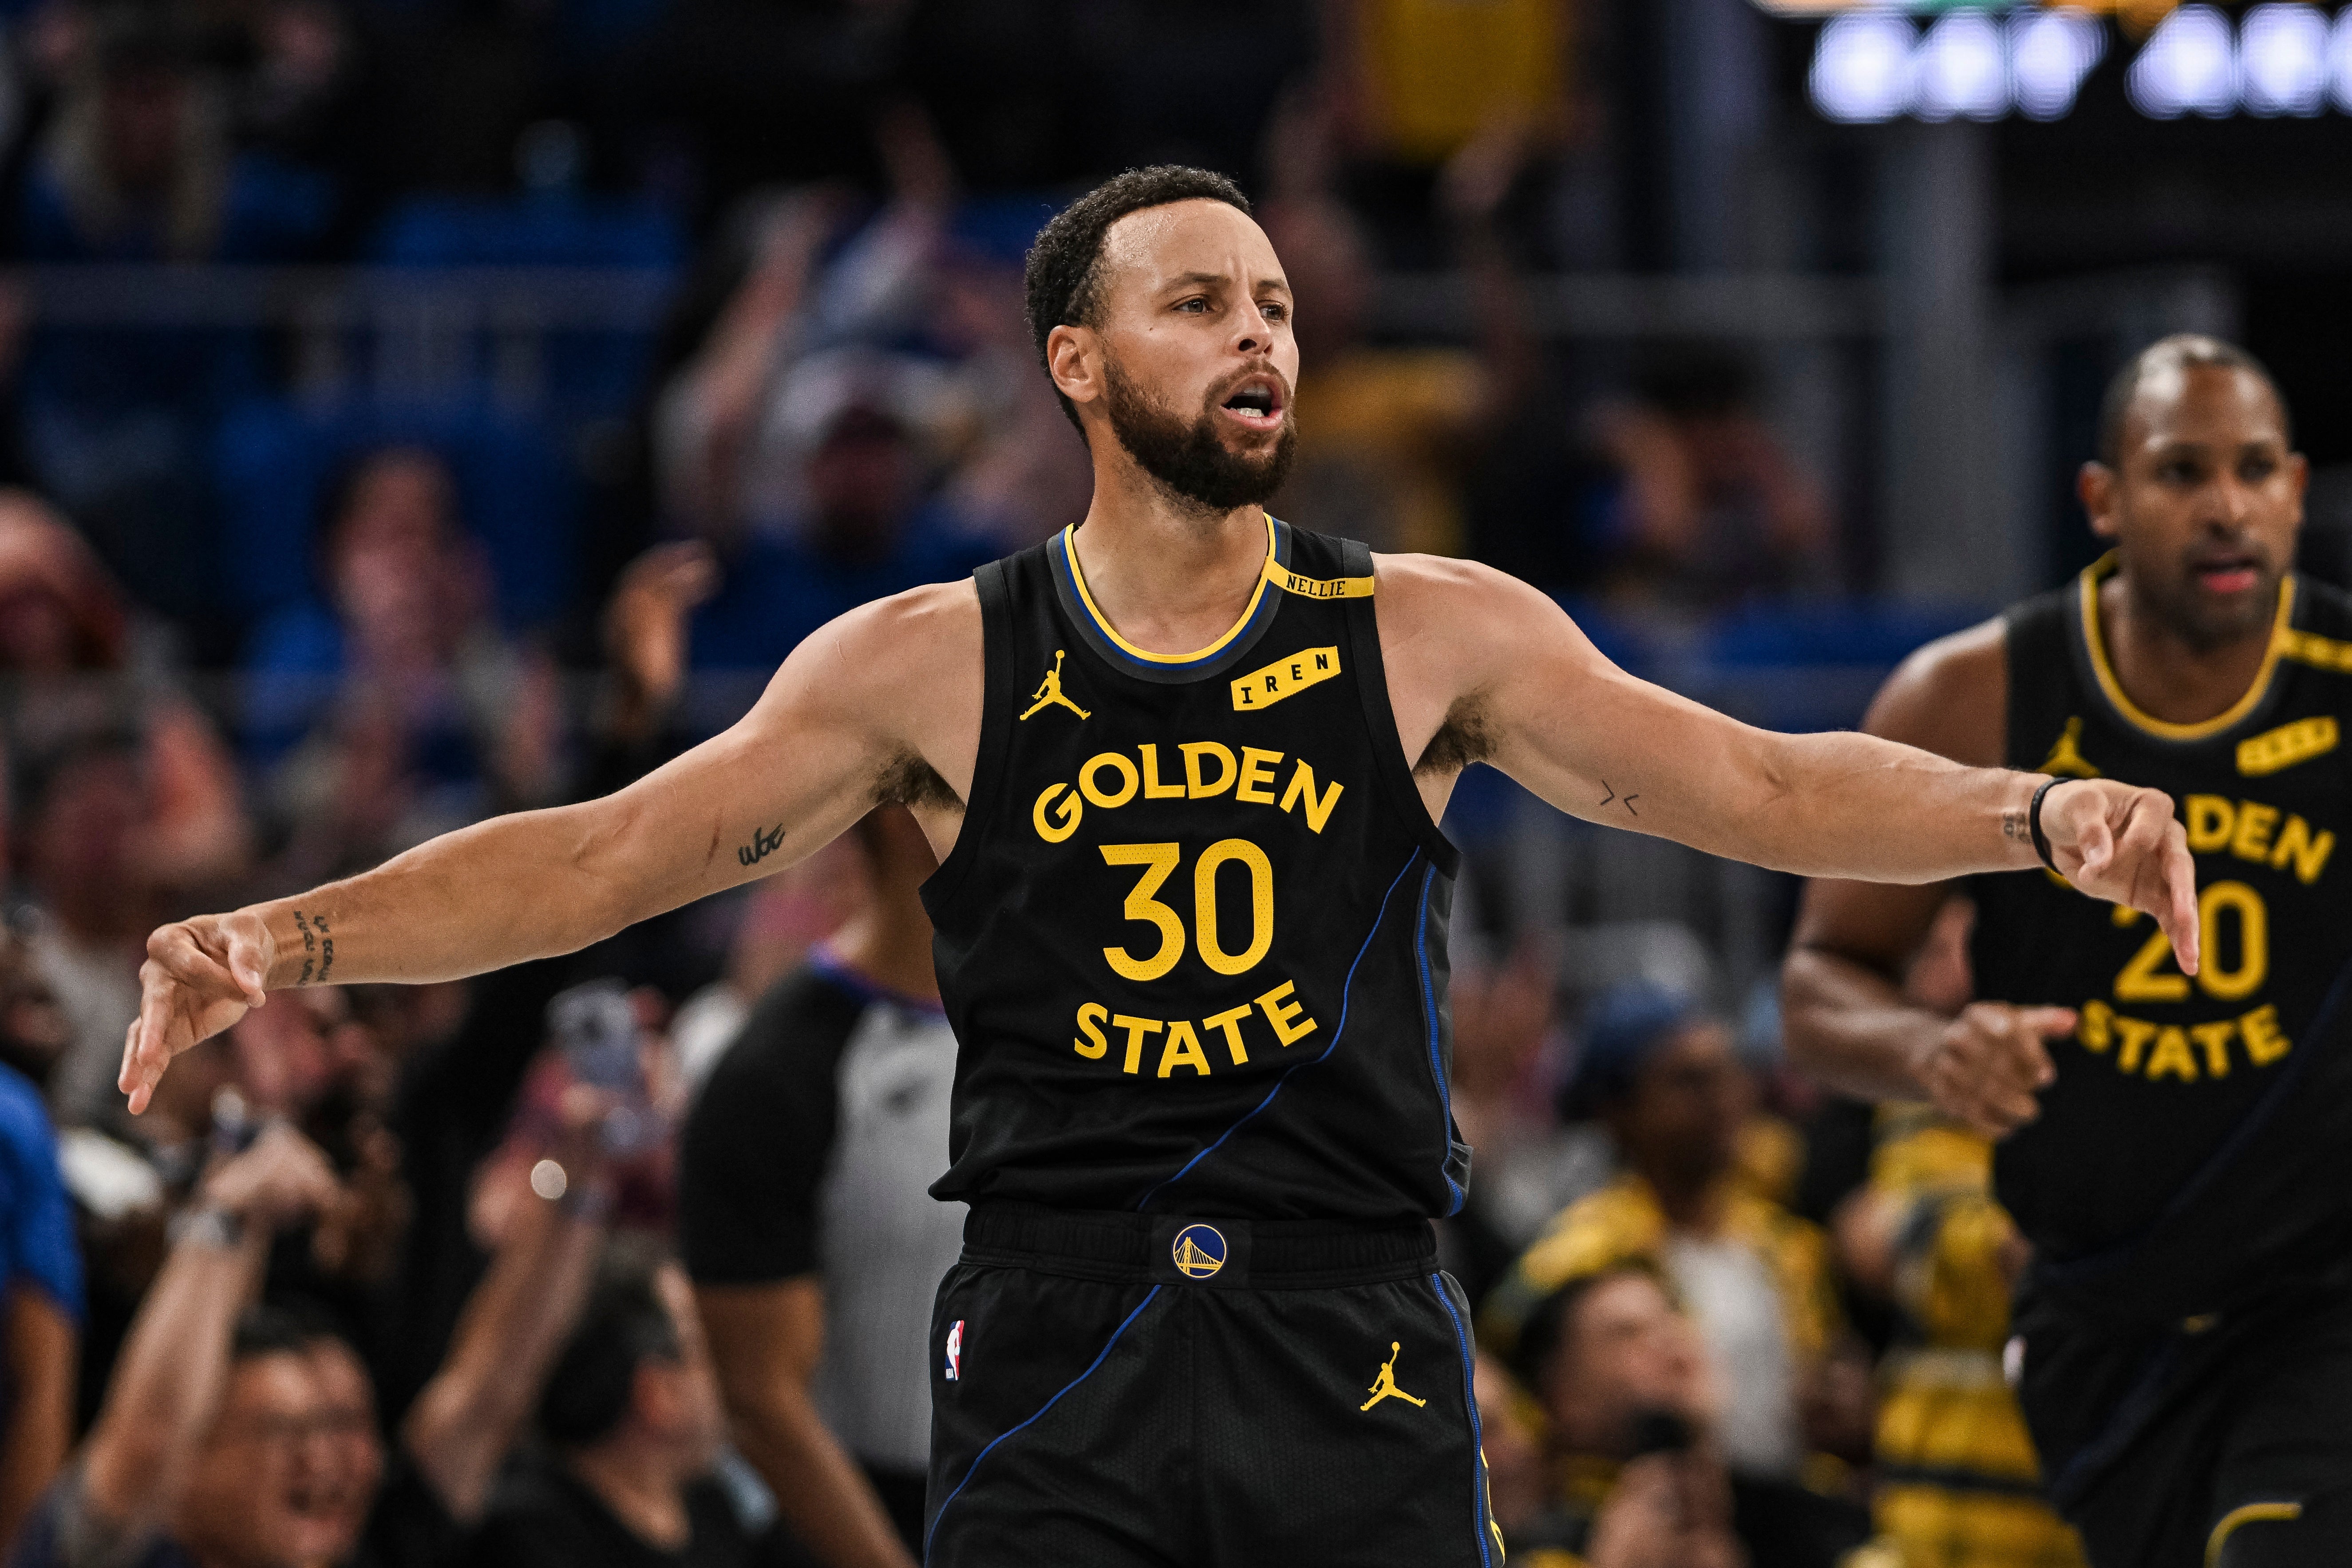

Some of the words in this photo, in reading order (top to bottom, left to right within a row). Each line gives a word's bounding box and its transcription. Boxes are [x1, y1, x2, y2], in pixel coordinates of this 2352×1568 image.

[1286, 574, 1346, 597] NELLIE
[1241, 653, 1328, 704] IREN
[1033, 742, 1344, 843] GOLDEN
[1099, 838, 1274, 981] 30
[2112, 880, 2268, 1001] 20
[1074, 980, 1318, 1078] STATE
[2079, 999, 2292, 1082] STATE
